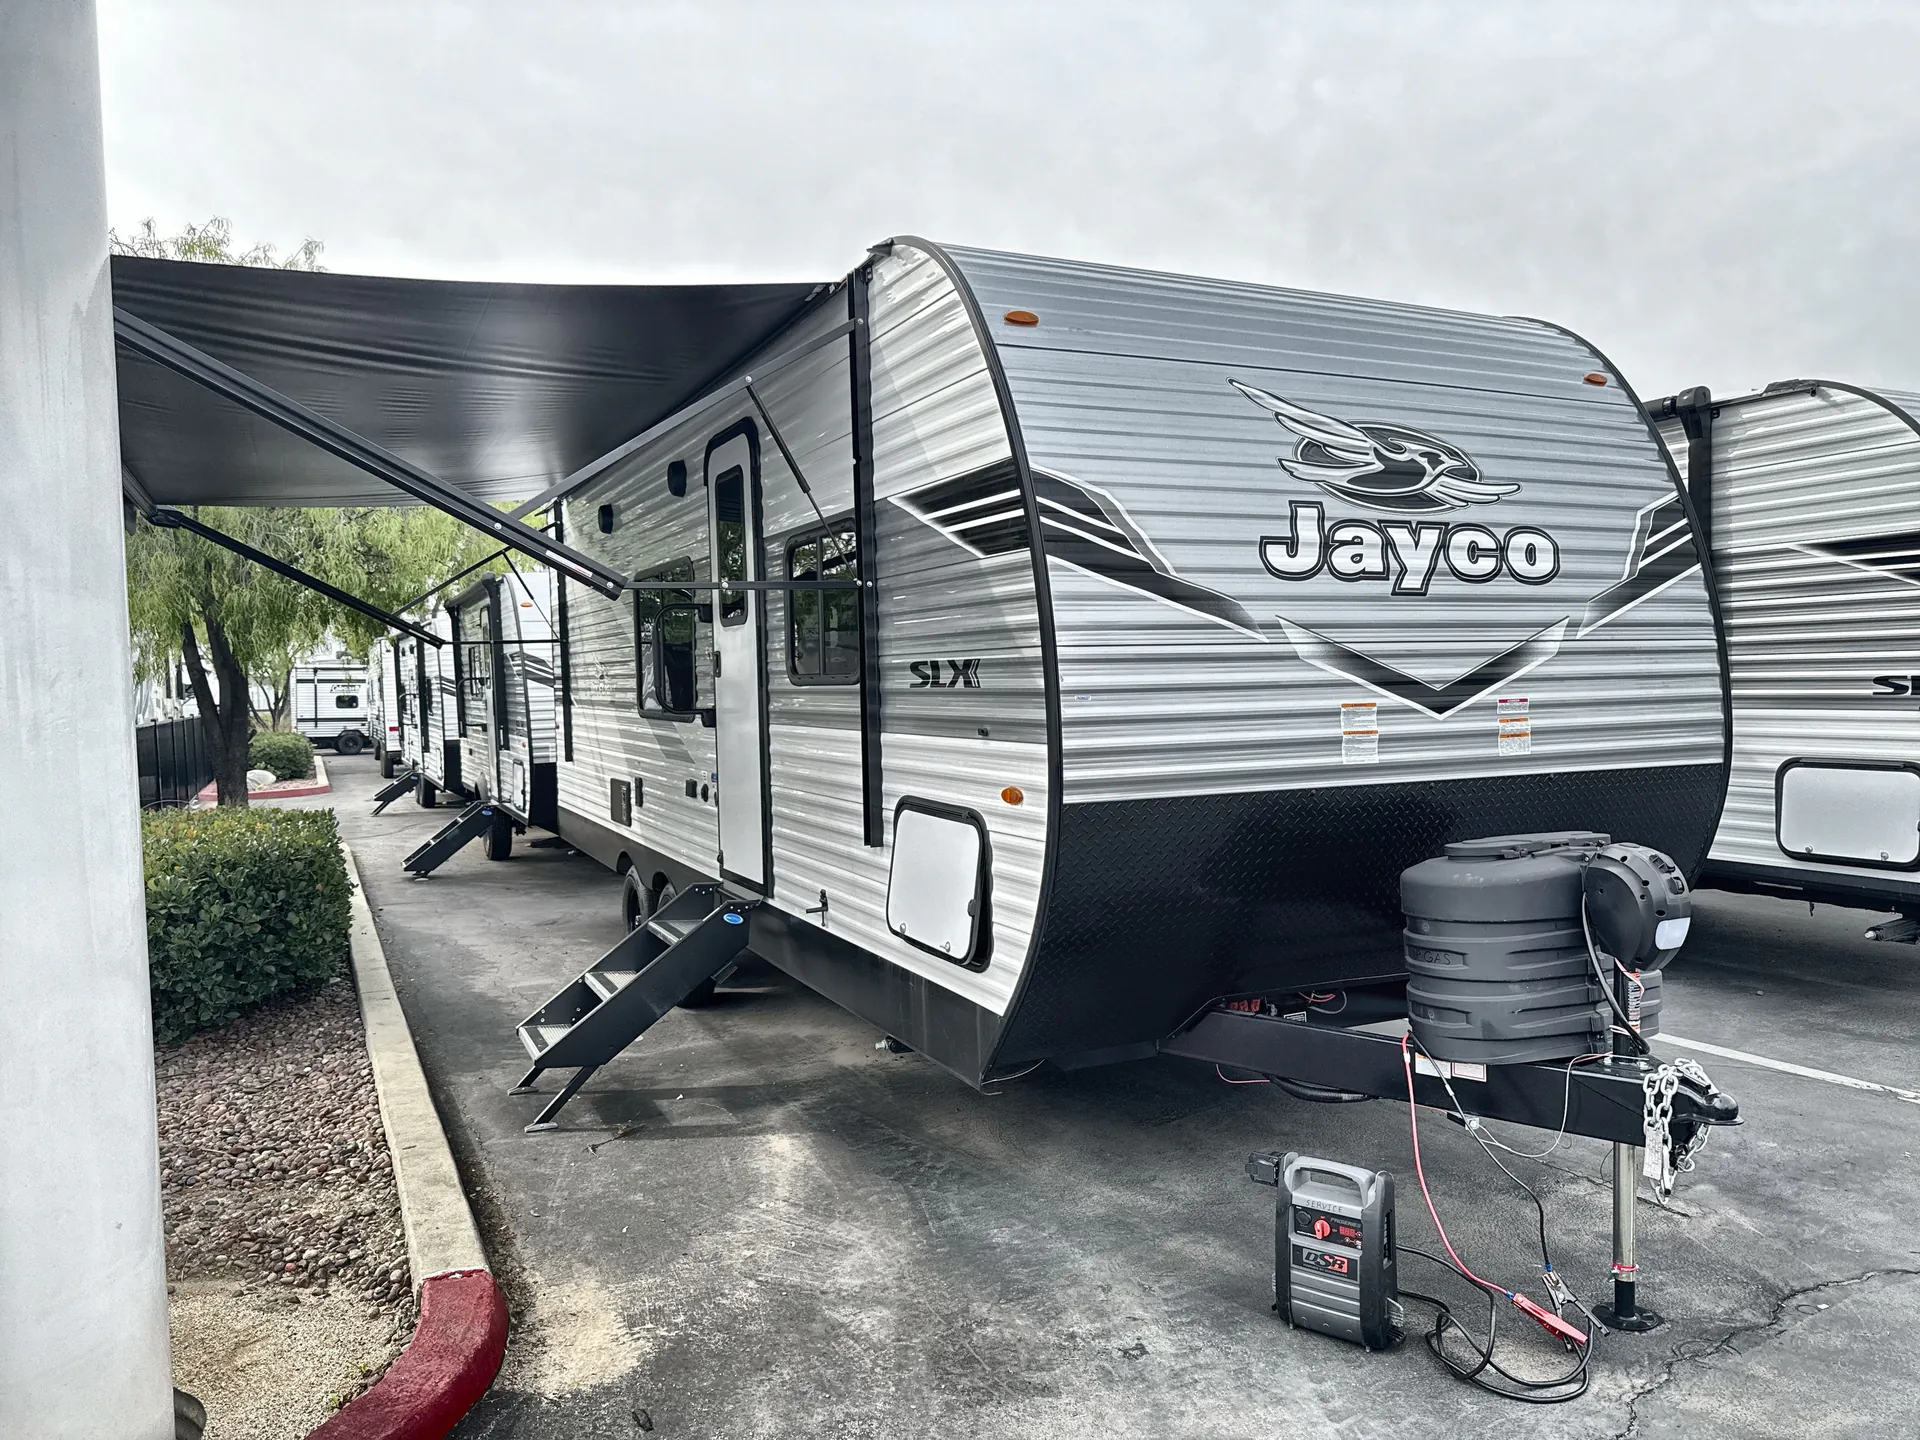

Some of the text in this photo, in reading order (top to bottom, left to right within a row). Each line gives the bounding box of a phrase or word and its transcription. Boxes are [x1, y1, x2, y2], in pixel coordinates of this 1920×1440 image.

[1258, 500, 1560, 597] Jayco
[909, 659, 981, 688] SLX
[1423, 950, 1451, 965] GAS
[1306, 1200, 1342, 1213] SERVICE
[1304, 1251, 1346, 1270] DSR
